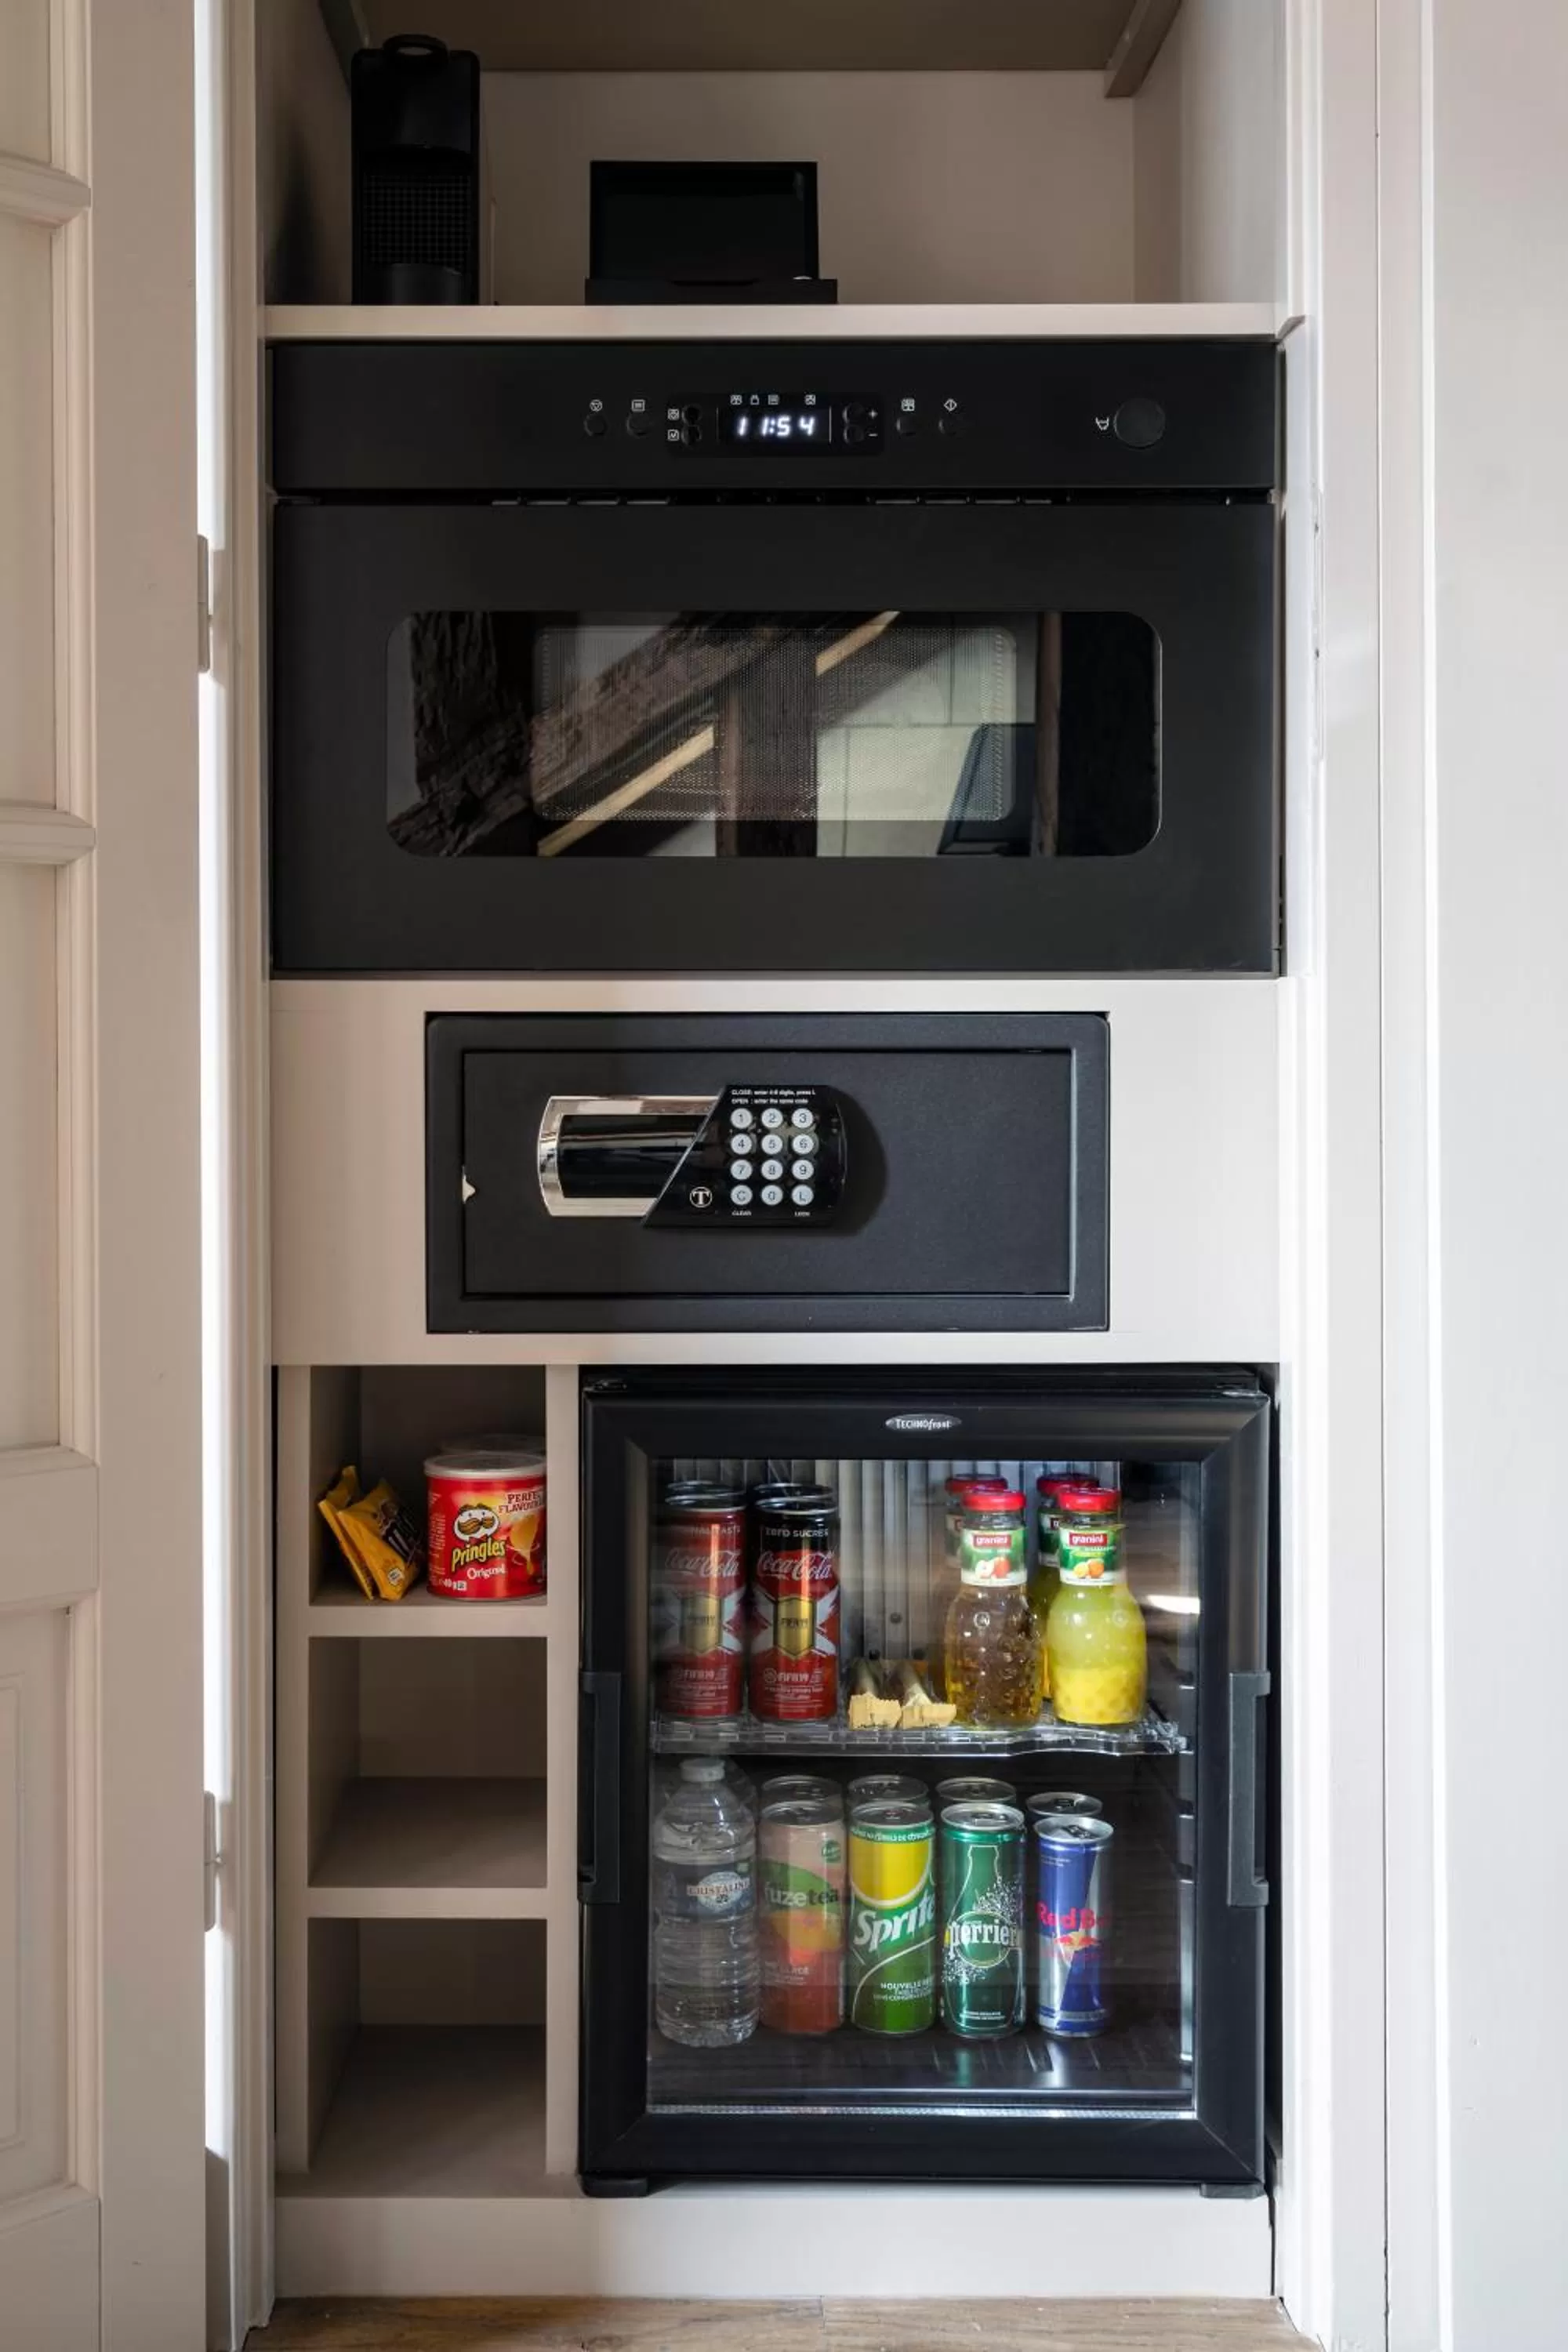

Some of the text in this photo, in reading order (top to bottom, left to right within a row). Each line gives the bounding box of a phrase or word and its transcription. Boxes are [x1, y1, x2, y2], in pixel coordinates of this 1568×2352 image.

[768, 1113, 776, 1123] 2
[799, 1113, 807, 1123] 3
[737, 1138, 807, 1149] 4 5 6
[738, 1164, 807, 1175] 7 8 9
[736, 1190, 746, 1201] C
[799, 1191, 807, 1201] L
[452, 1539, 506, 1572] Pringles
[466, 1563, 506, 1580] Original
[1035, 1900, 1076, 1930] Red
